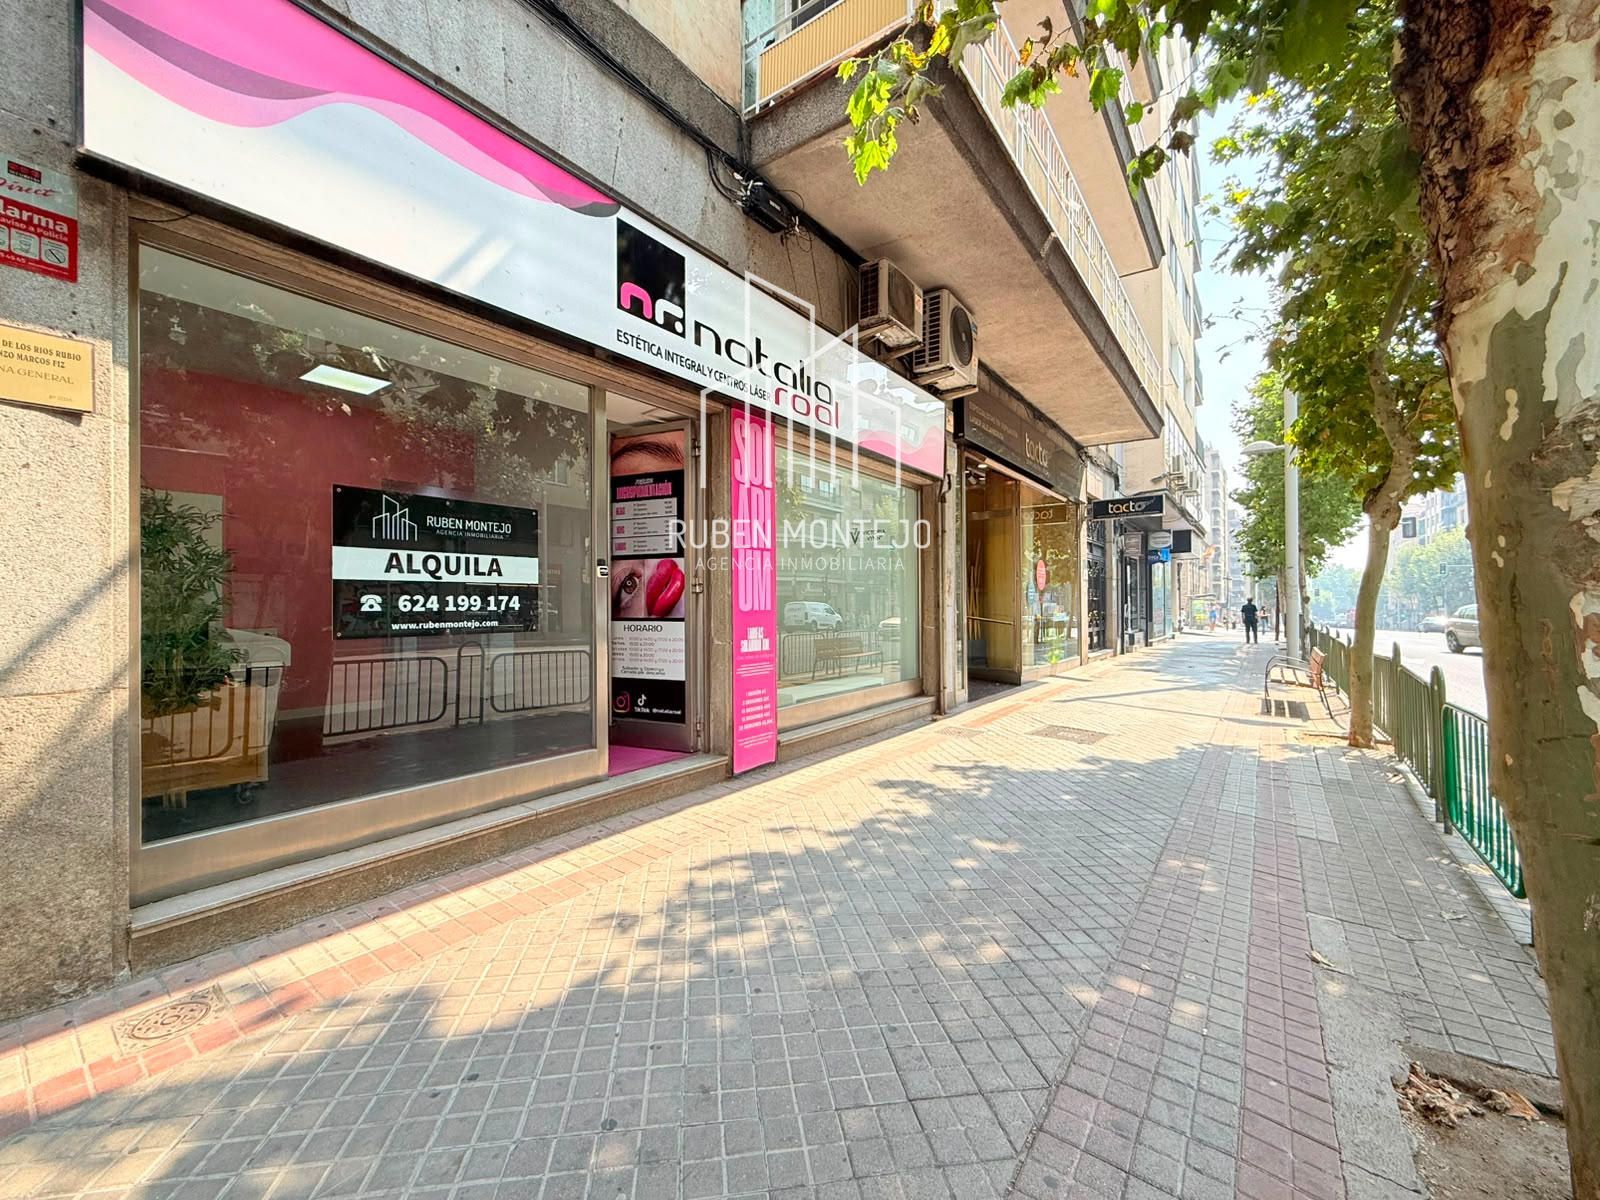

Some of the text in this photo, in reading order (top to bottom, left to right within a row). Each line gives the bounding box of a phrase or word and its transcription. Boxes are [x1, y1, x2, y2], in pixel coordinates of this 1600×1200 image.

[2, 339, 82, 362] DE LOS RIOS RUBIO
[17, 352, 51, 366] MARCOS
[53, 360, 66, 369] FIZ
[617, 329, 663, 359] ESTÉTICA
[664, 348, 708, 376] INTEGRAL
[706, 366, 713, 379] Y
[714, 370, 748, 393] CENTROS
[693, 320, 834, 405] natalia
[17, 368, 74, 385] GENERAL
[733, 417, 772, 489] SOL
[1108, 500, 1146, 514] tacto
[426, 515, 512, 534] RUBEN MONTEJO
[436, 529, 504, 540] AGENCIA INMOBILIARIA
[384, 552, 503, 580] ALQUILA
[398, 594, 521, 612] 624 199 174
[391, 619, 499, 630] www.rubenmontejo.com
[623, 624, 663, 633] HORARIO
